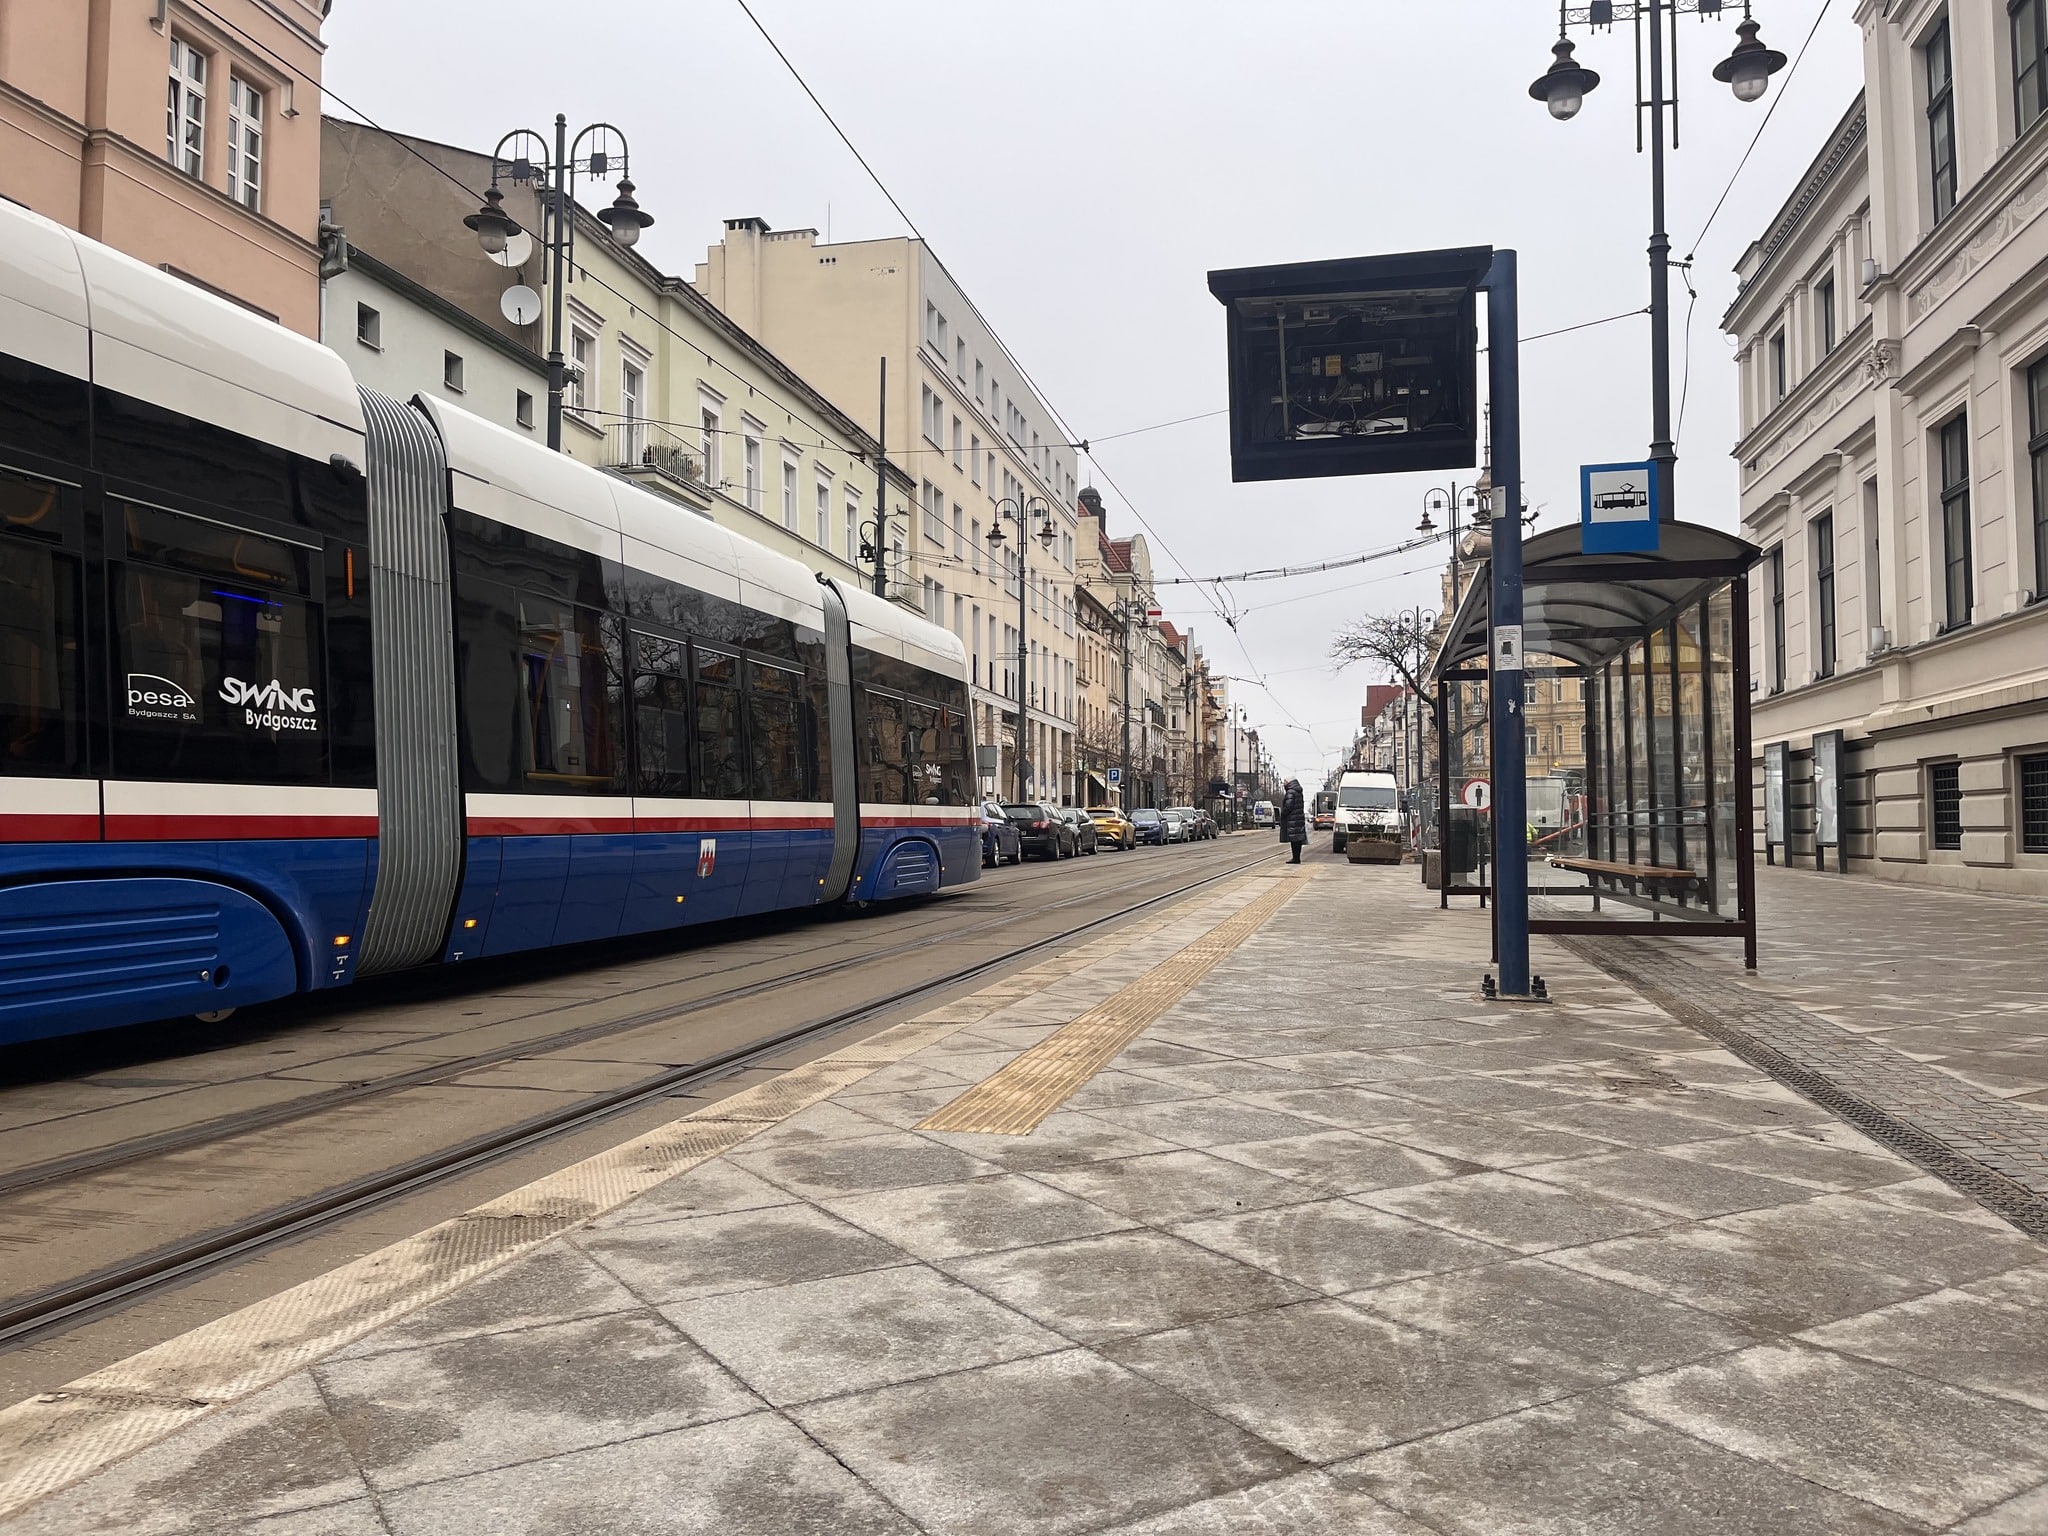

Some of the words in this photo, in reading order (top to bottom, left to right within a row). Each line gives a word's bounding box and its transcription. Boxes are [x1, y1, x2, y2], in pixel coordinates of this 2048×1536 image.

[128, 690, 187, 707] pesa
[128, 708, 178, 719] Bydgoszcz
[182, 712, 197, 720] SA
[245, 708, 317, 731] Bydgoszcz
